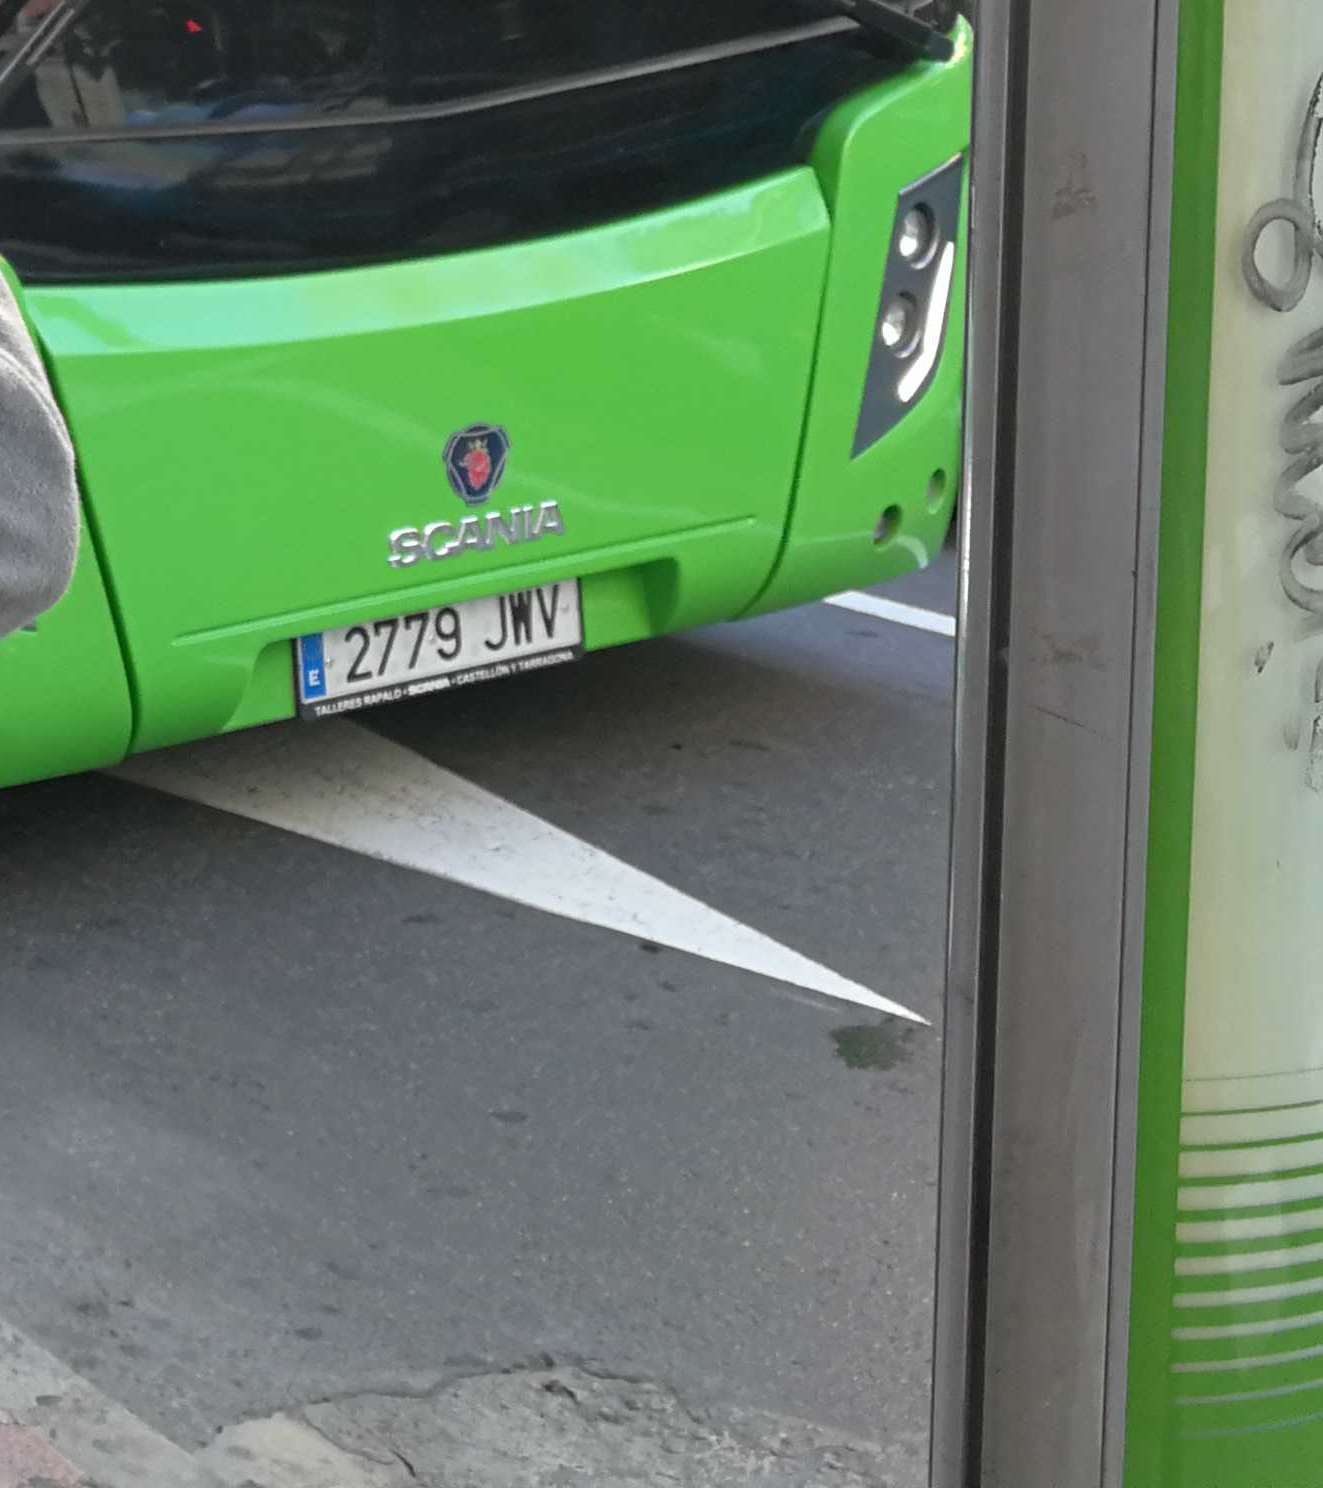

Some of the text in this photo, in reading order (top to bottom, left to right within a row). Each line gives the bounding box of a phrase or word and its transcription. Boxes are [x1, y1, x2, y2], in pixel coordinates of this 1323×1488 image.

[388, 500, 565, 568] SCANIA
[344, 584, 560, 683] 2779 JWV
[308, 669, 321, 687] E
[315, 698, 362, 717] TALLERES
